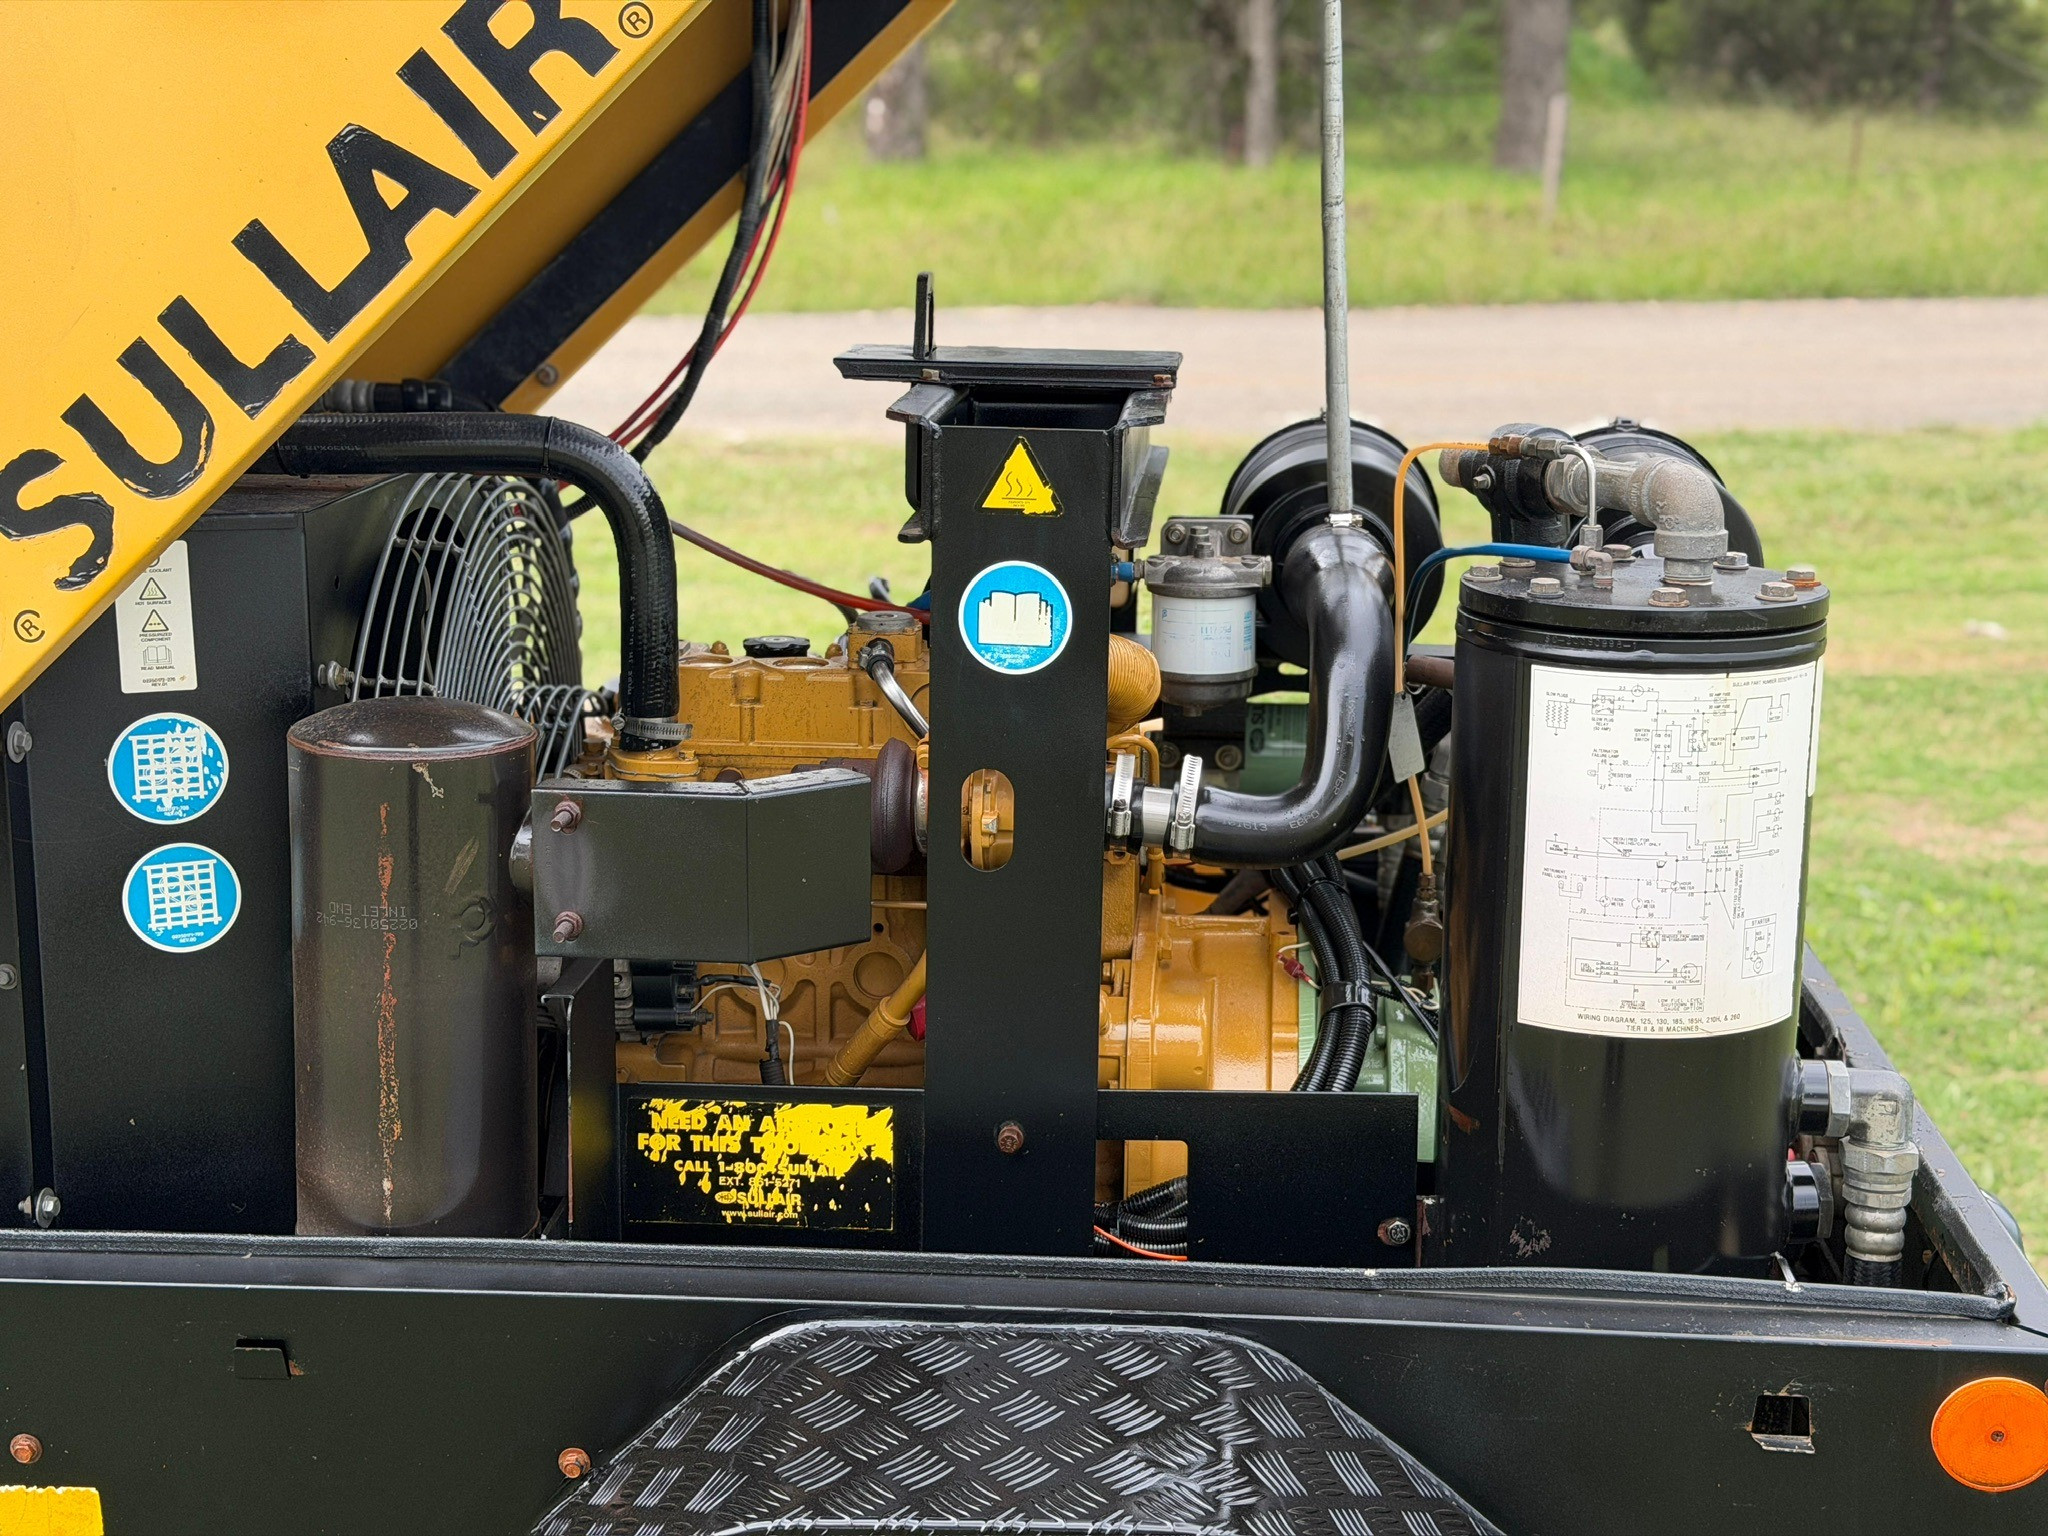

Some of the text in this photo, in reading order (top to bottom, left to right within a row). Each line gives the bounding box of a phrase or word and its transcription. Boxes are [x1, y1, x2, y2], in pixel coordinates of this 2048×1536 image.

[0, 0, 620, 592] SULLAIR
[329, 901, 406, 918] INLET END
[316, 911, 418, 930] 02250136-942
[1752, 918, 1770, 926] STARTER
[1577, 1013, 1601, 1021] WIRING
[1603, 1016, 1637, 1024] DIAGRAM,
[652, 1112, 707, 1130] NEED
[717, 1114, 751, 1131] AN
[638, 1133, 681, 1151] FOR
[690, 1135, 741, 1153] THIS
[674, 1160, 712, 1172] CALL
[718, 1176, 800, 1188] EXT. 861-5271
[737, 1192, 802, 1206] SULLAIR
[721, 1210, 798, 1219] www.sullair.com
